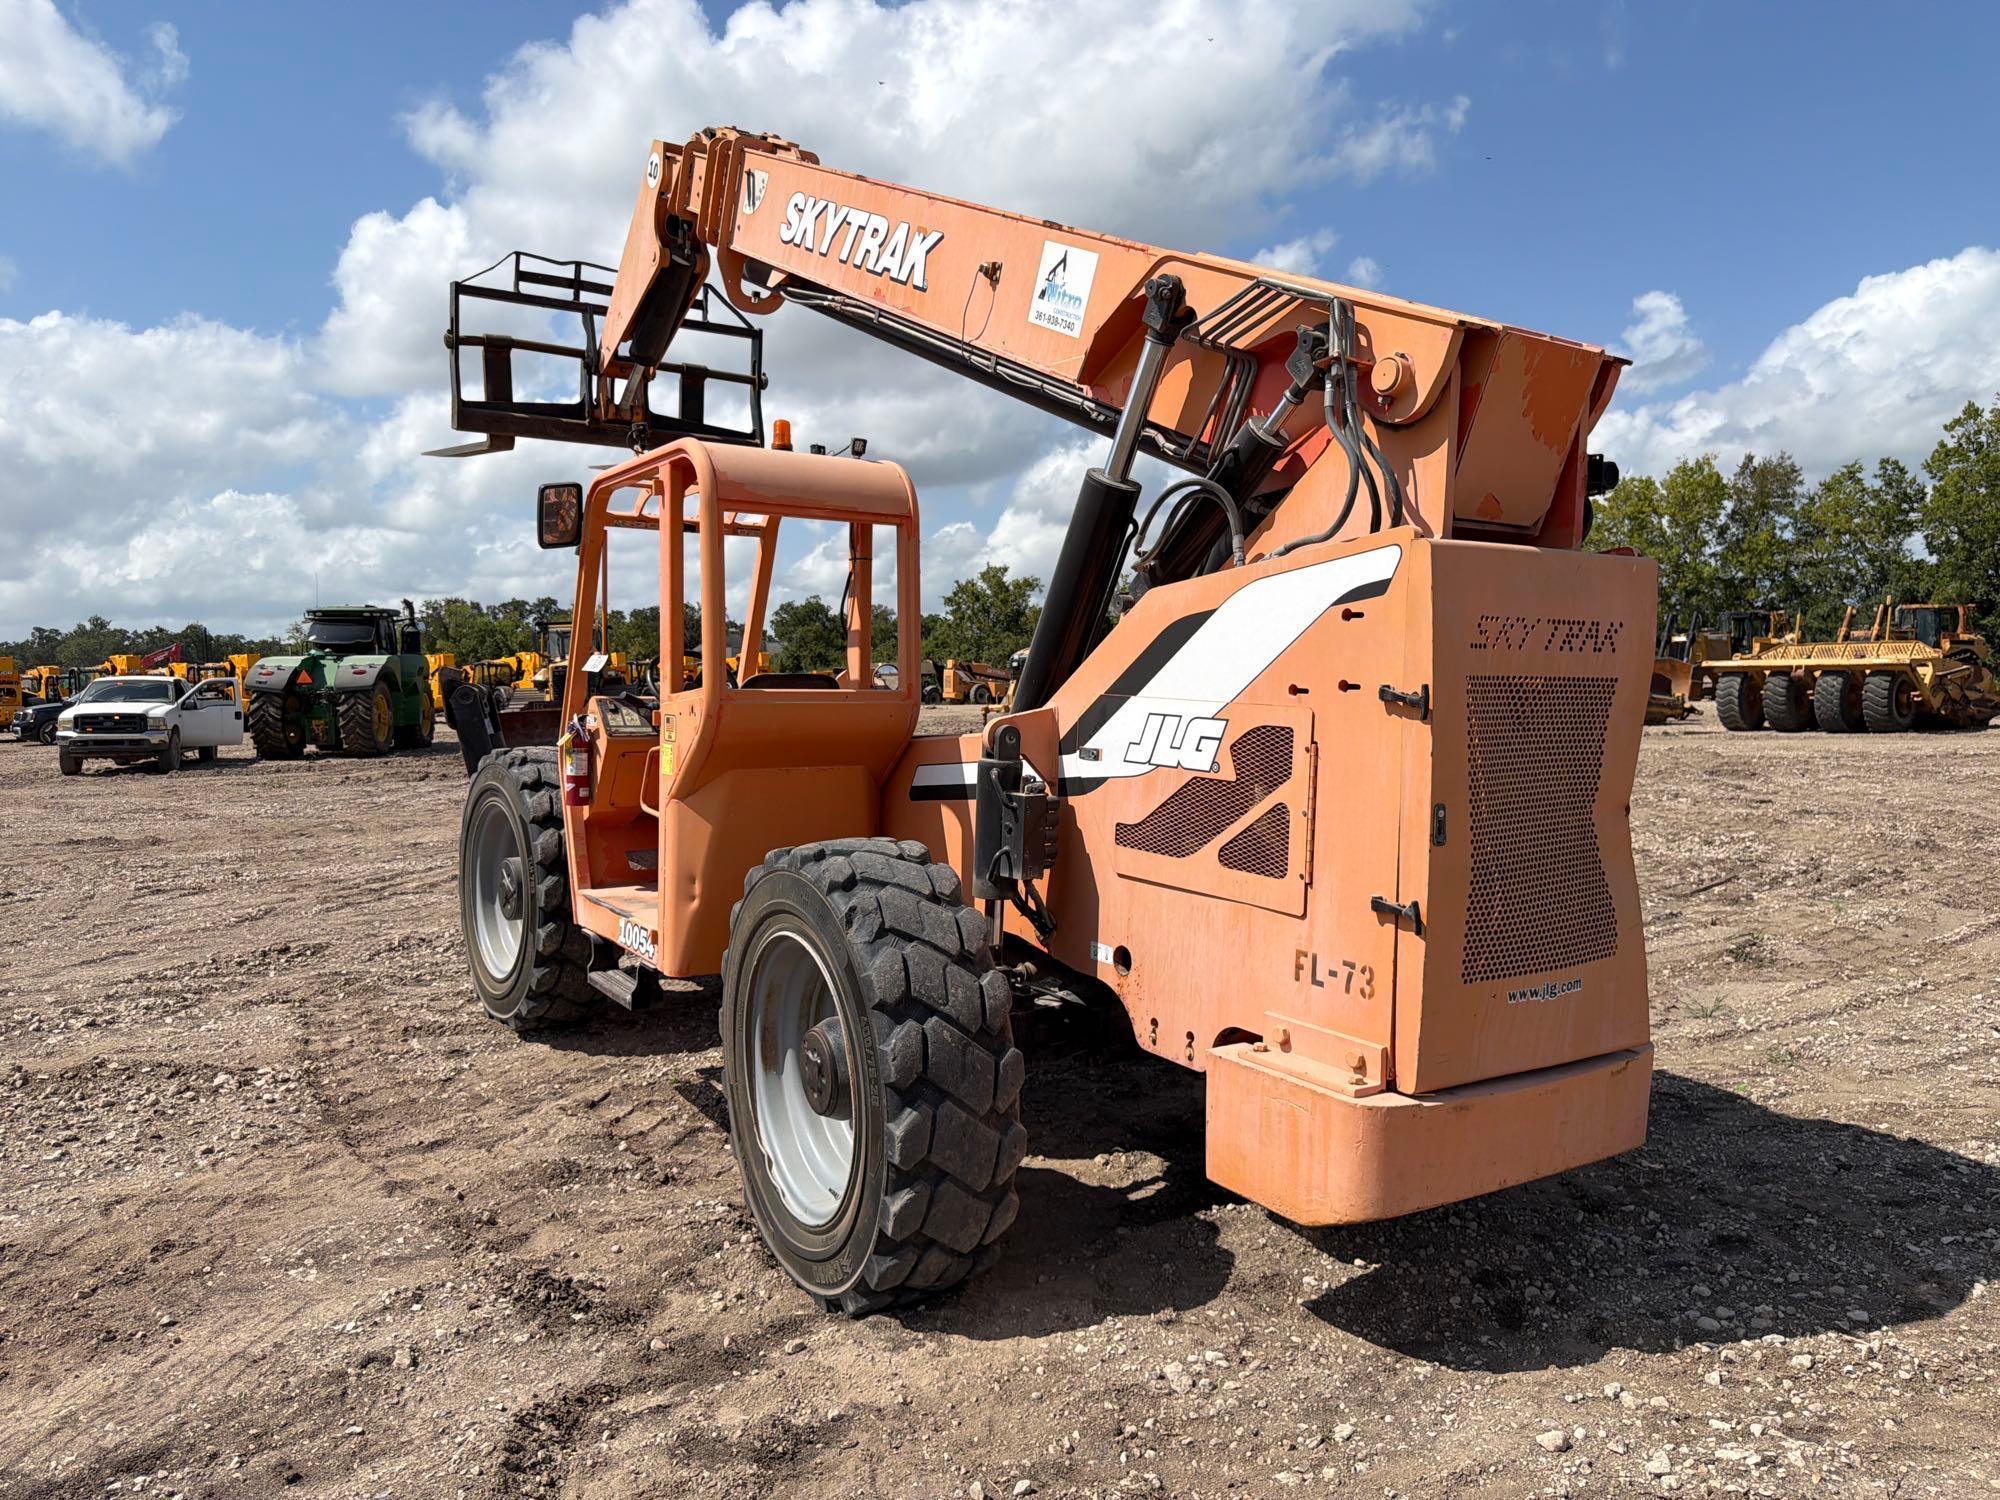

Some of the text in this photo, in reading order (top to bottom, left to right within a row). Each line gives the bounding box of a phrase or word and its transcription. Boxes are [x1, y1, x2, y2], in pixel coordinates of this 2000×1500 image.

[648, 160, 659, 180] 10
[779, 191, 944, 293] SKYTRAK
[1034, 310, 1075, 332] 361-938-7340
[1470, 614, 1624, 654] SKY TRAK
[1123, 712, 1229, 773] JLG
[619, 918, 655, 960] 10054
[1294, 948, 1375, 1000] FL-73
[1508, 979, 1582, 1003] www.jlg.com
